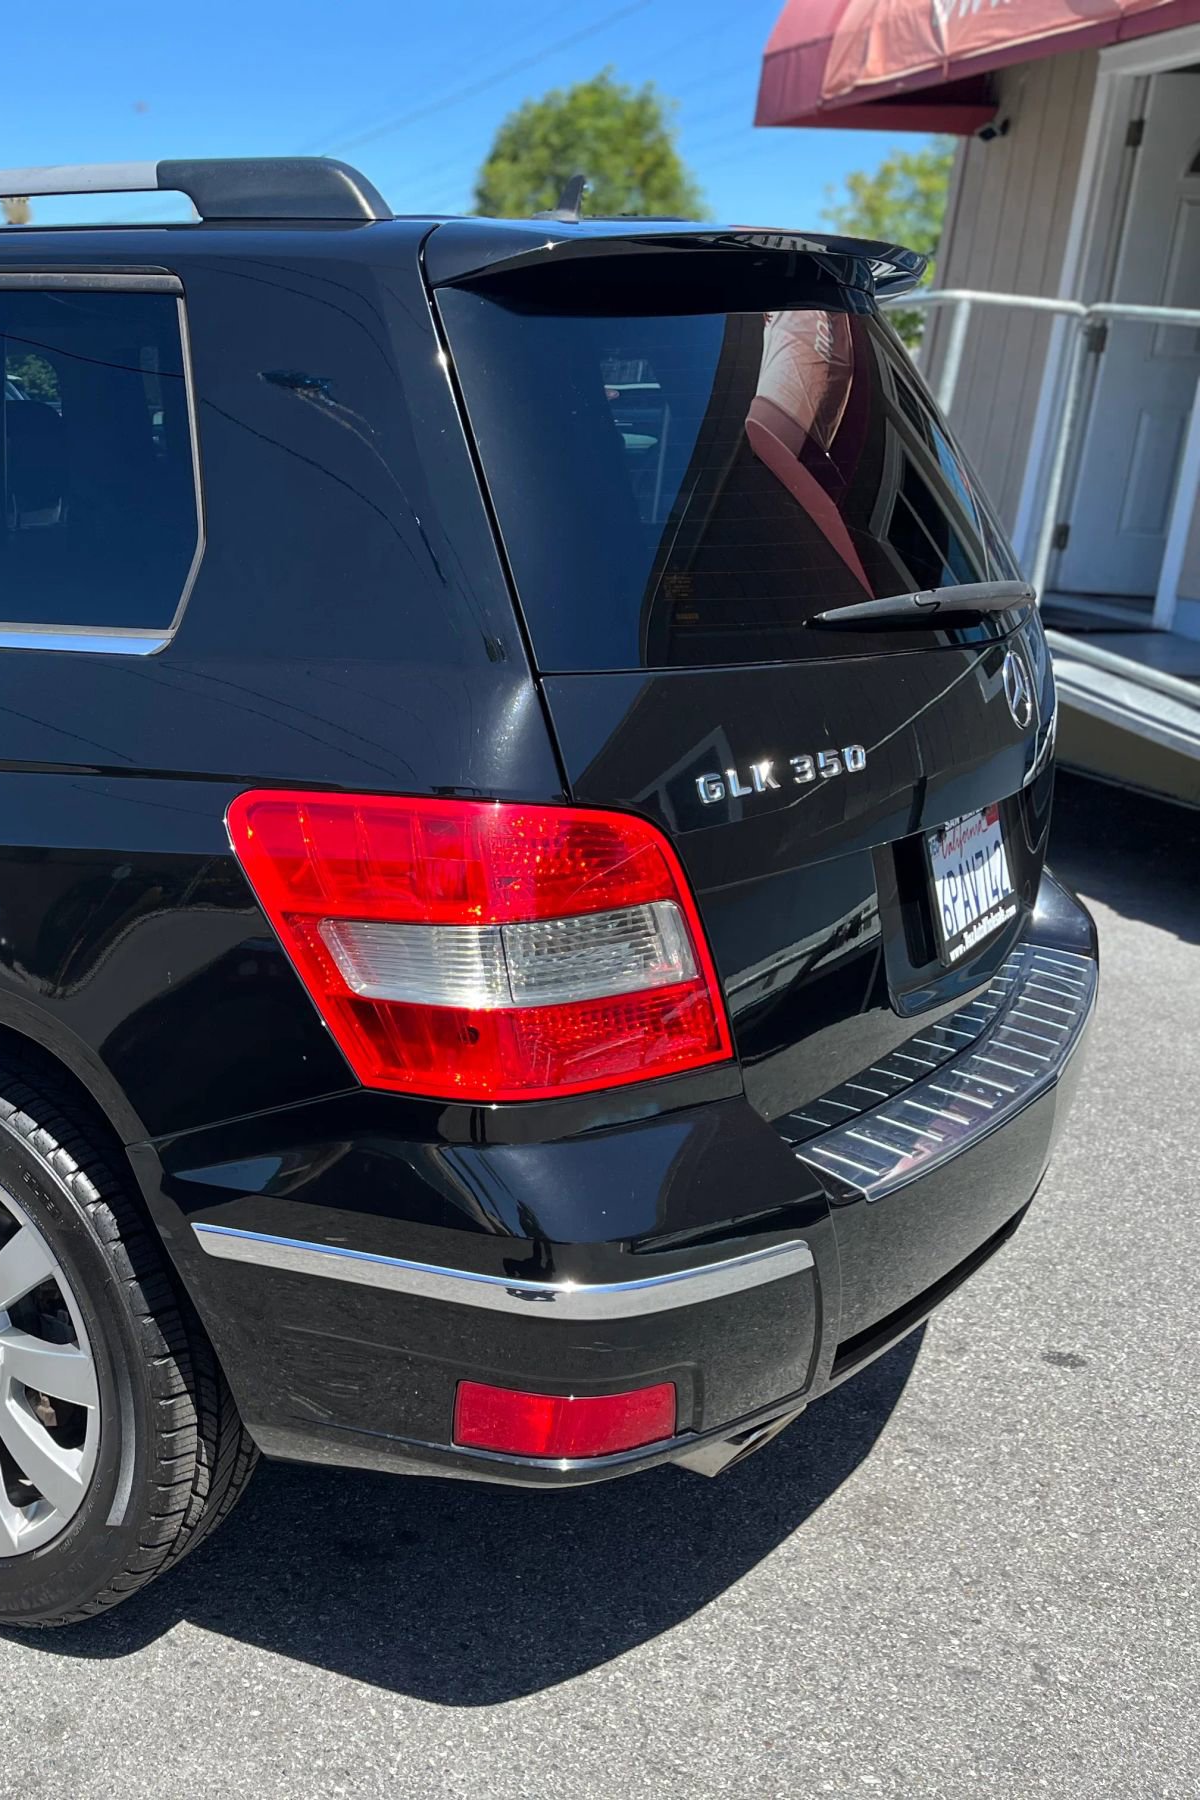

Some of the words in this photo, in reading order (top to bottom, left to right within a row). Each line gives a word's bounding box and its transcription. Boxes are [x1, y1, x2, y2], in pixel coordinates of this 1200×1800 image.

[696, 760, 782, 805] GLK
[789, 744, 867, 783] 350
[942, 839, 1009, 937] 6PAV742
